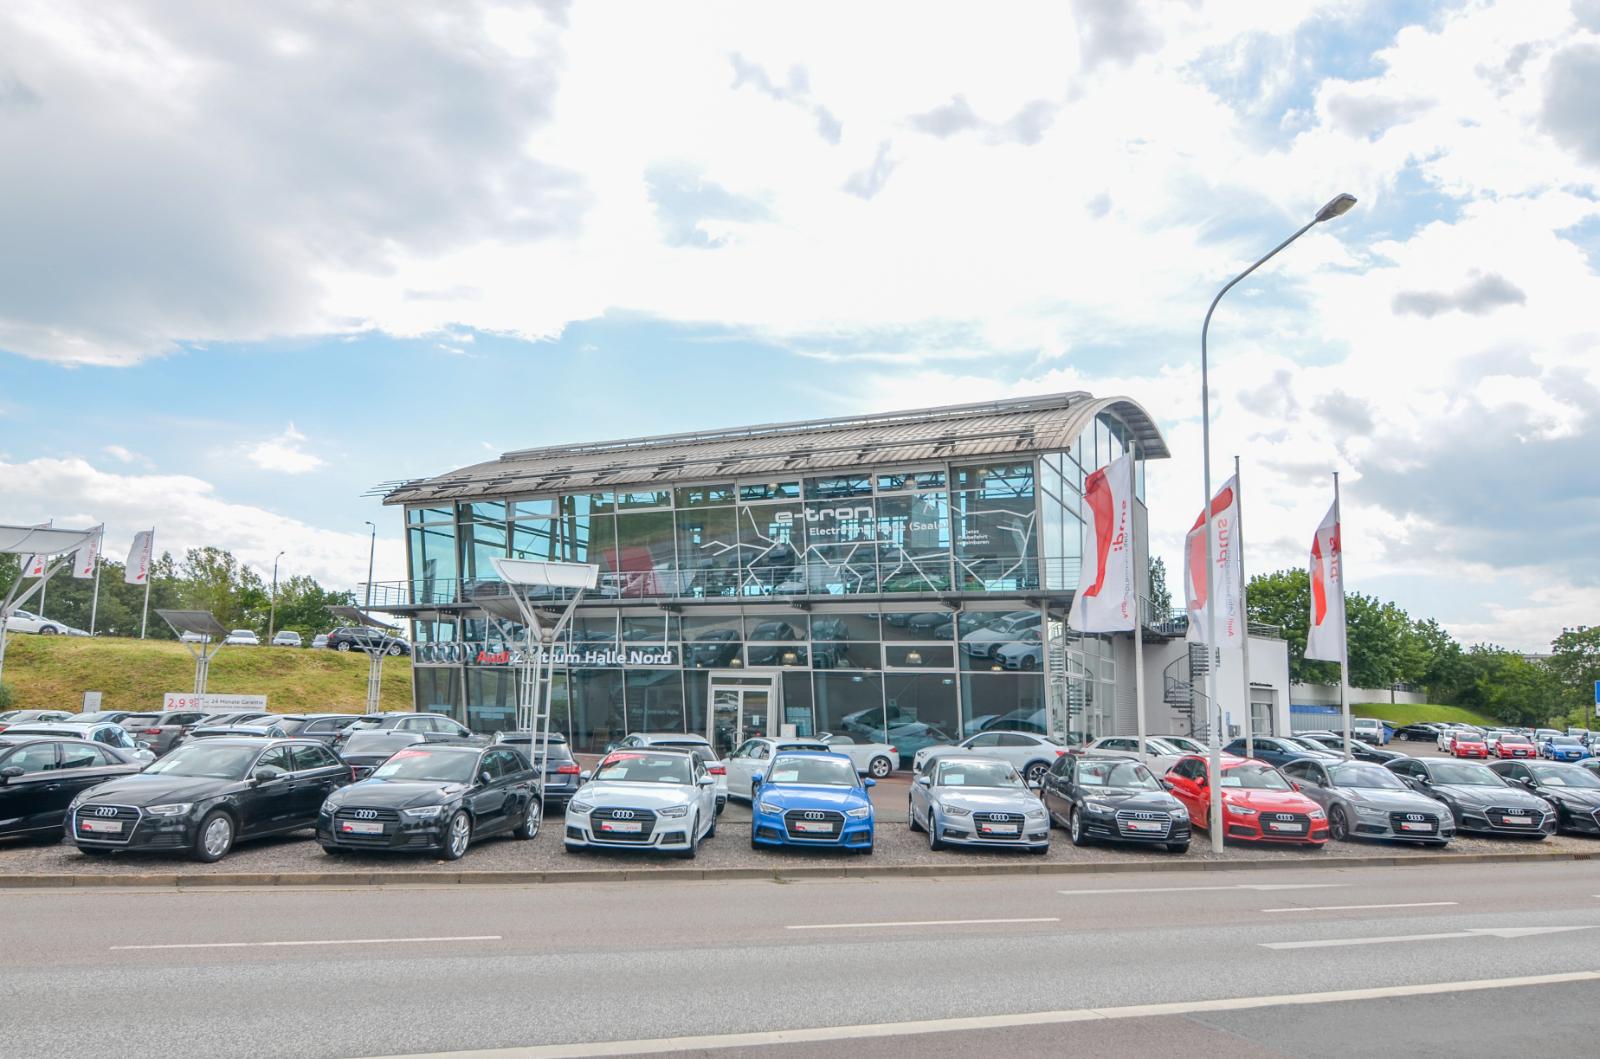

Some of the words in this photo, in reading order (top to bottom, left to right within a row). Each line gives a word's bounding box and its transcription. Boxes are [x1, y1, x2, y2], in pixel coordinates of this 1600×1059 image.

[774, 506, 874, 524] e-tron
[476, 650, 510, 664] Audi
[513, 651, 580, 664] Ztum
[585, 651, 626, 664] Halle
[630, 651, 672, 664] Nord
[168, 698, 186, 709] 2,9
